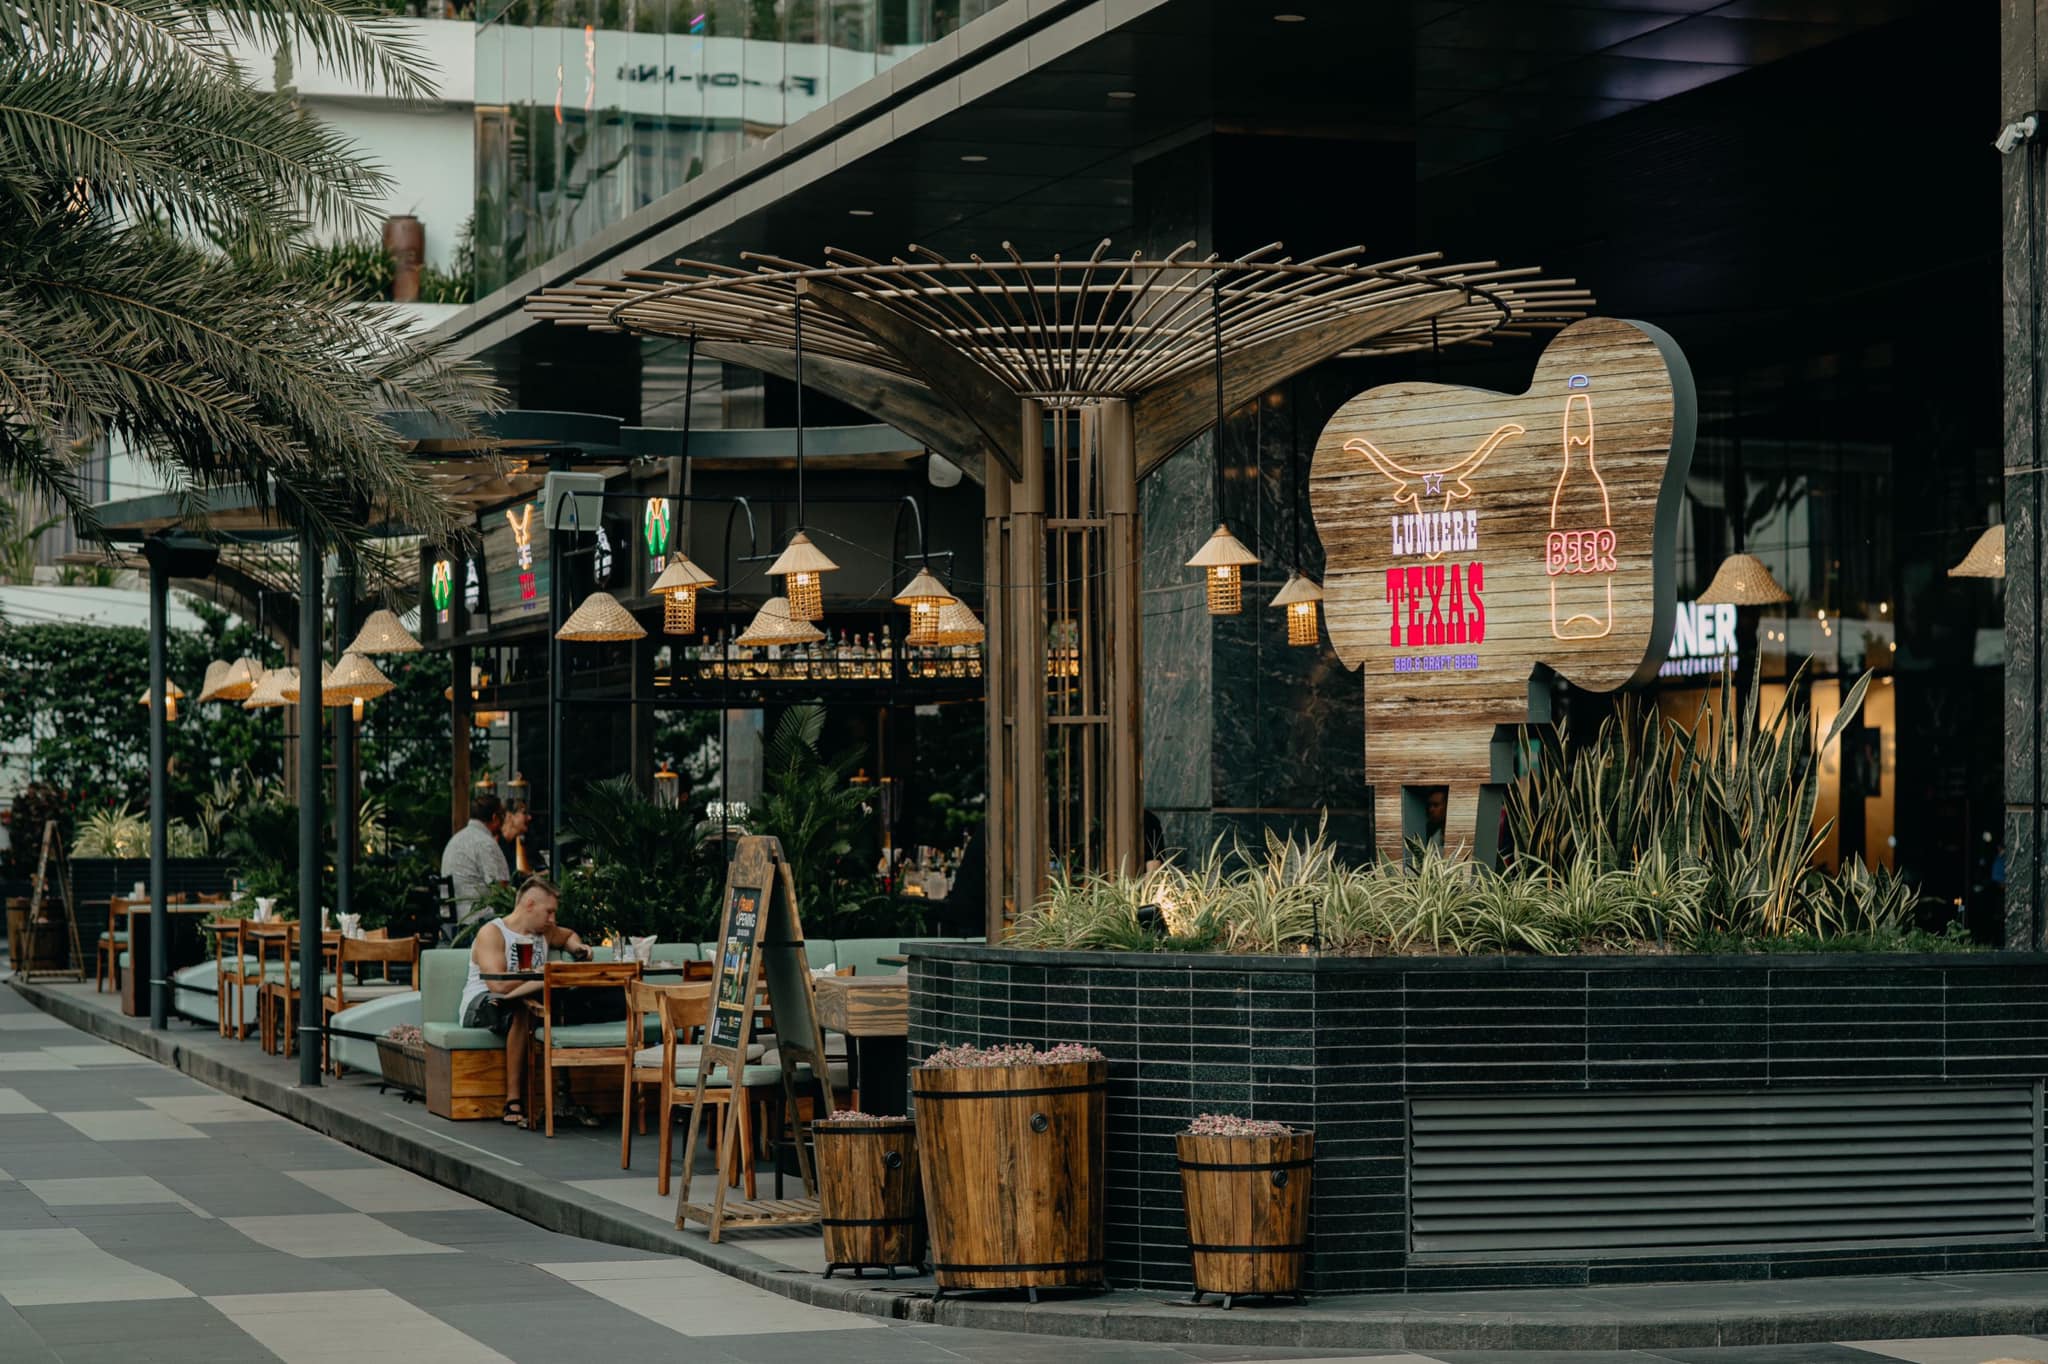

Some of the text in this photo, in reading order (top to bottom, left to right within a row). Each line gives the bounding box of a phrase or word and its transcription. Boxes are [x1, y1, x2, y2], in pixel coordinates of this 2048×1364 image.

[1391, 510, 1478, 555] LUMIERE
[1546, 529, 1617, 576] BEER
[1385, 561, 1486, 648] TEXAS
[1454, 654, 1479, 670] BEER
